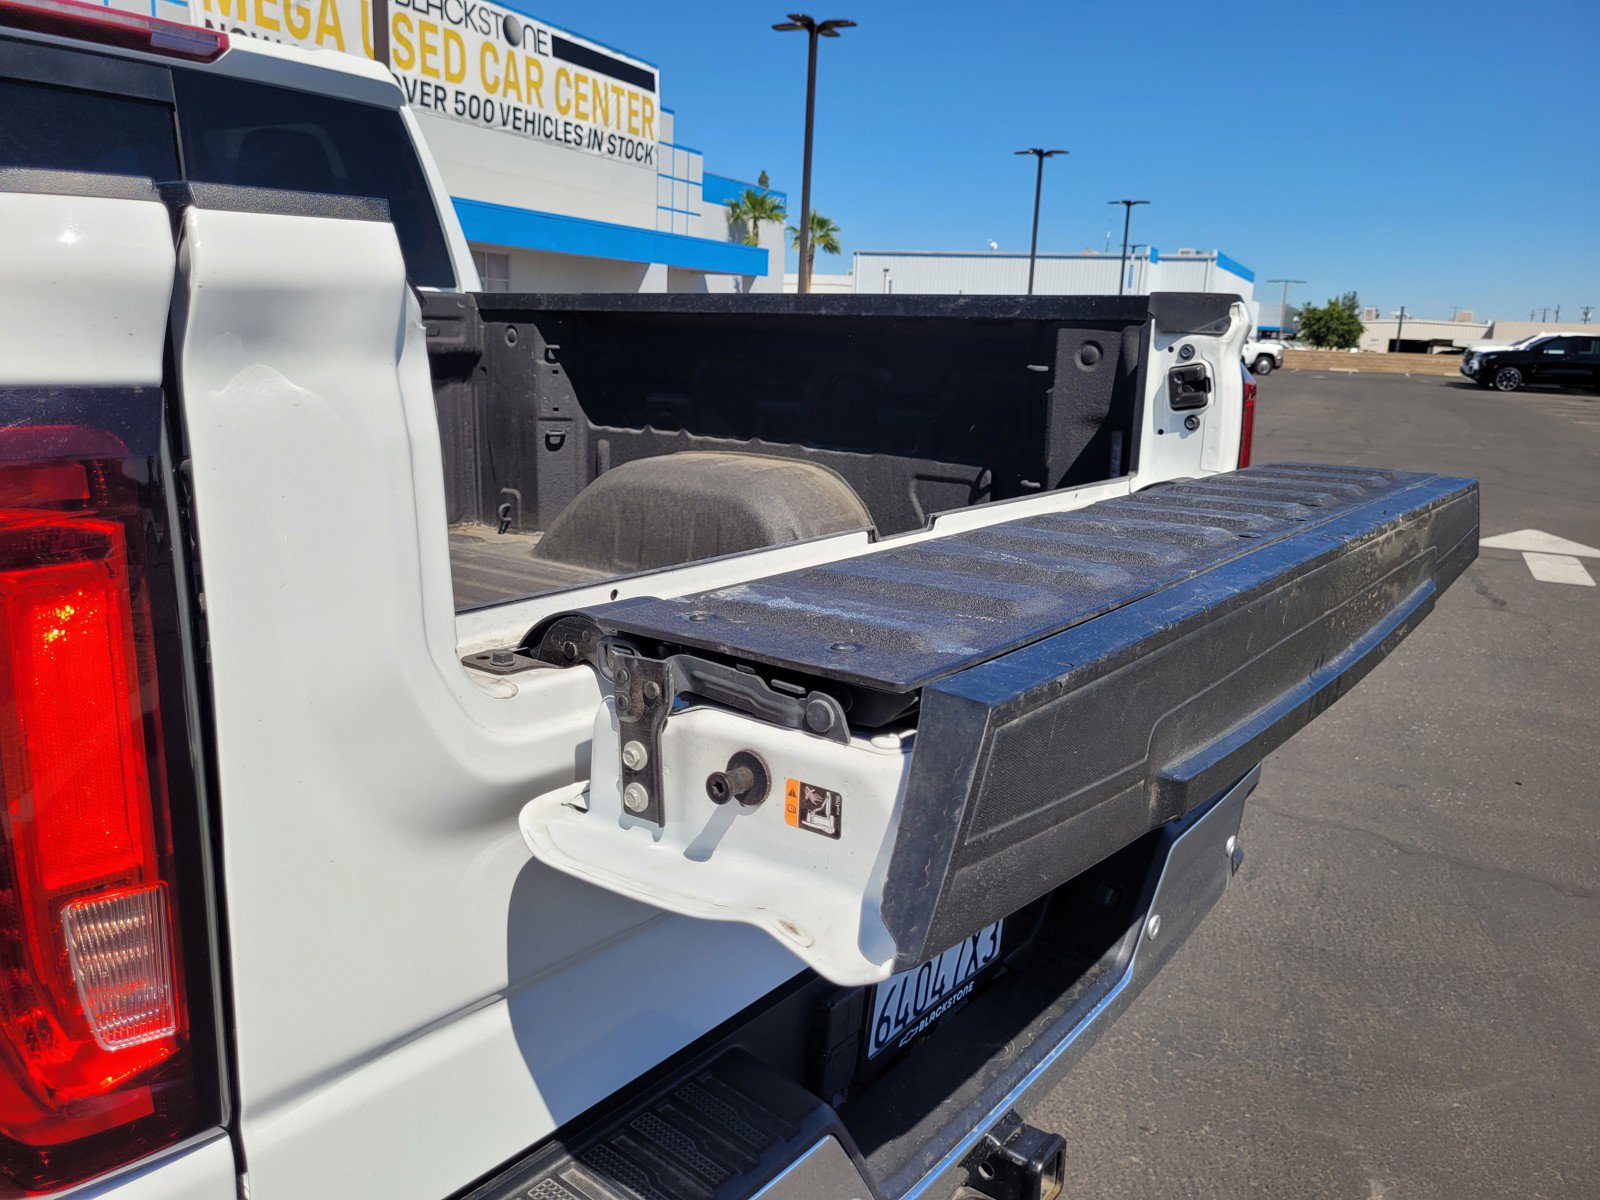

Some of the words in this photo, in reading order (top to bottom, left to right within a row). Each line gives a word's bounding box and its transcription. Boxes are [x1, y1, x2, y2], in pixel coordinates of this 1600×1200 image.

[395, 0, 549, 57] ACKSTONE
[480, 41, 544, 109] CAR
[555, 67, 655, 140] CENTER
[454, 90, 495, 124] 500
[500, 102, 584, 147] VEHICLES
[587, 127, 604, 152] IN
[607, 133, 654, 165] STOCK
[918, 980, 975, 1032] BLACKSTONE
